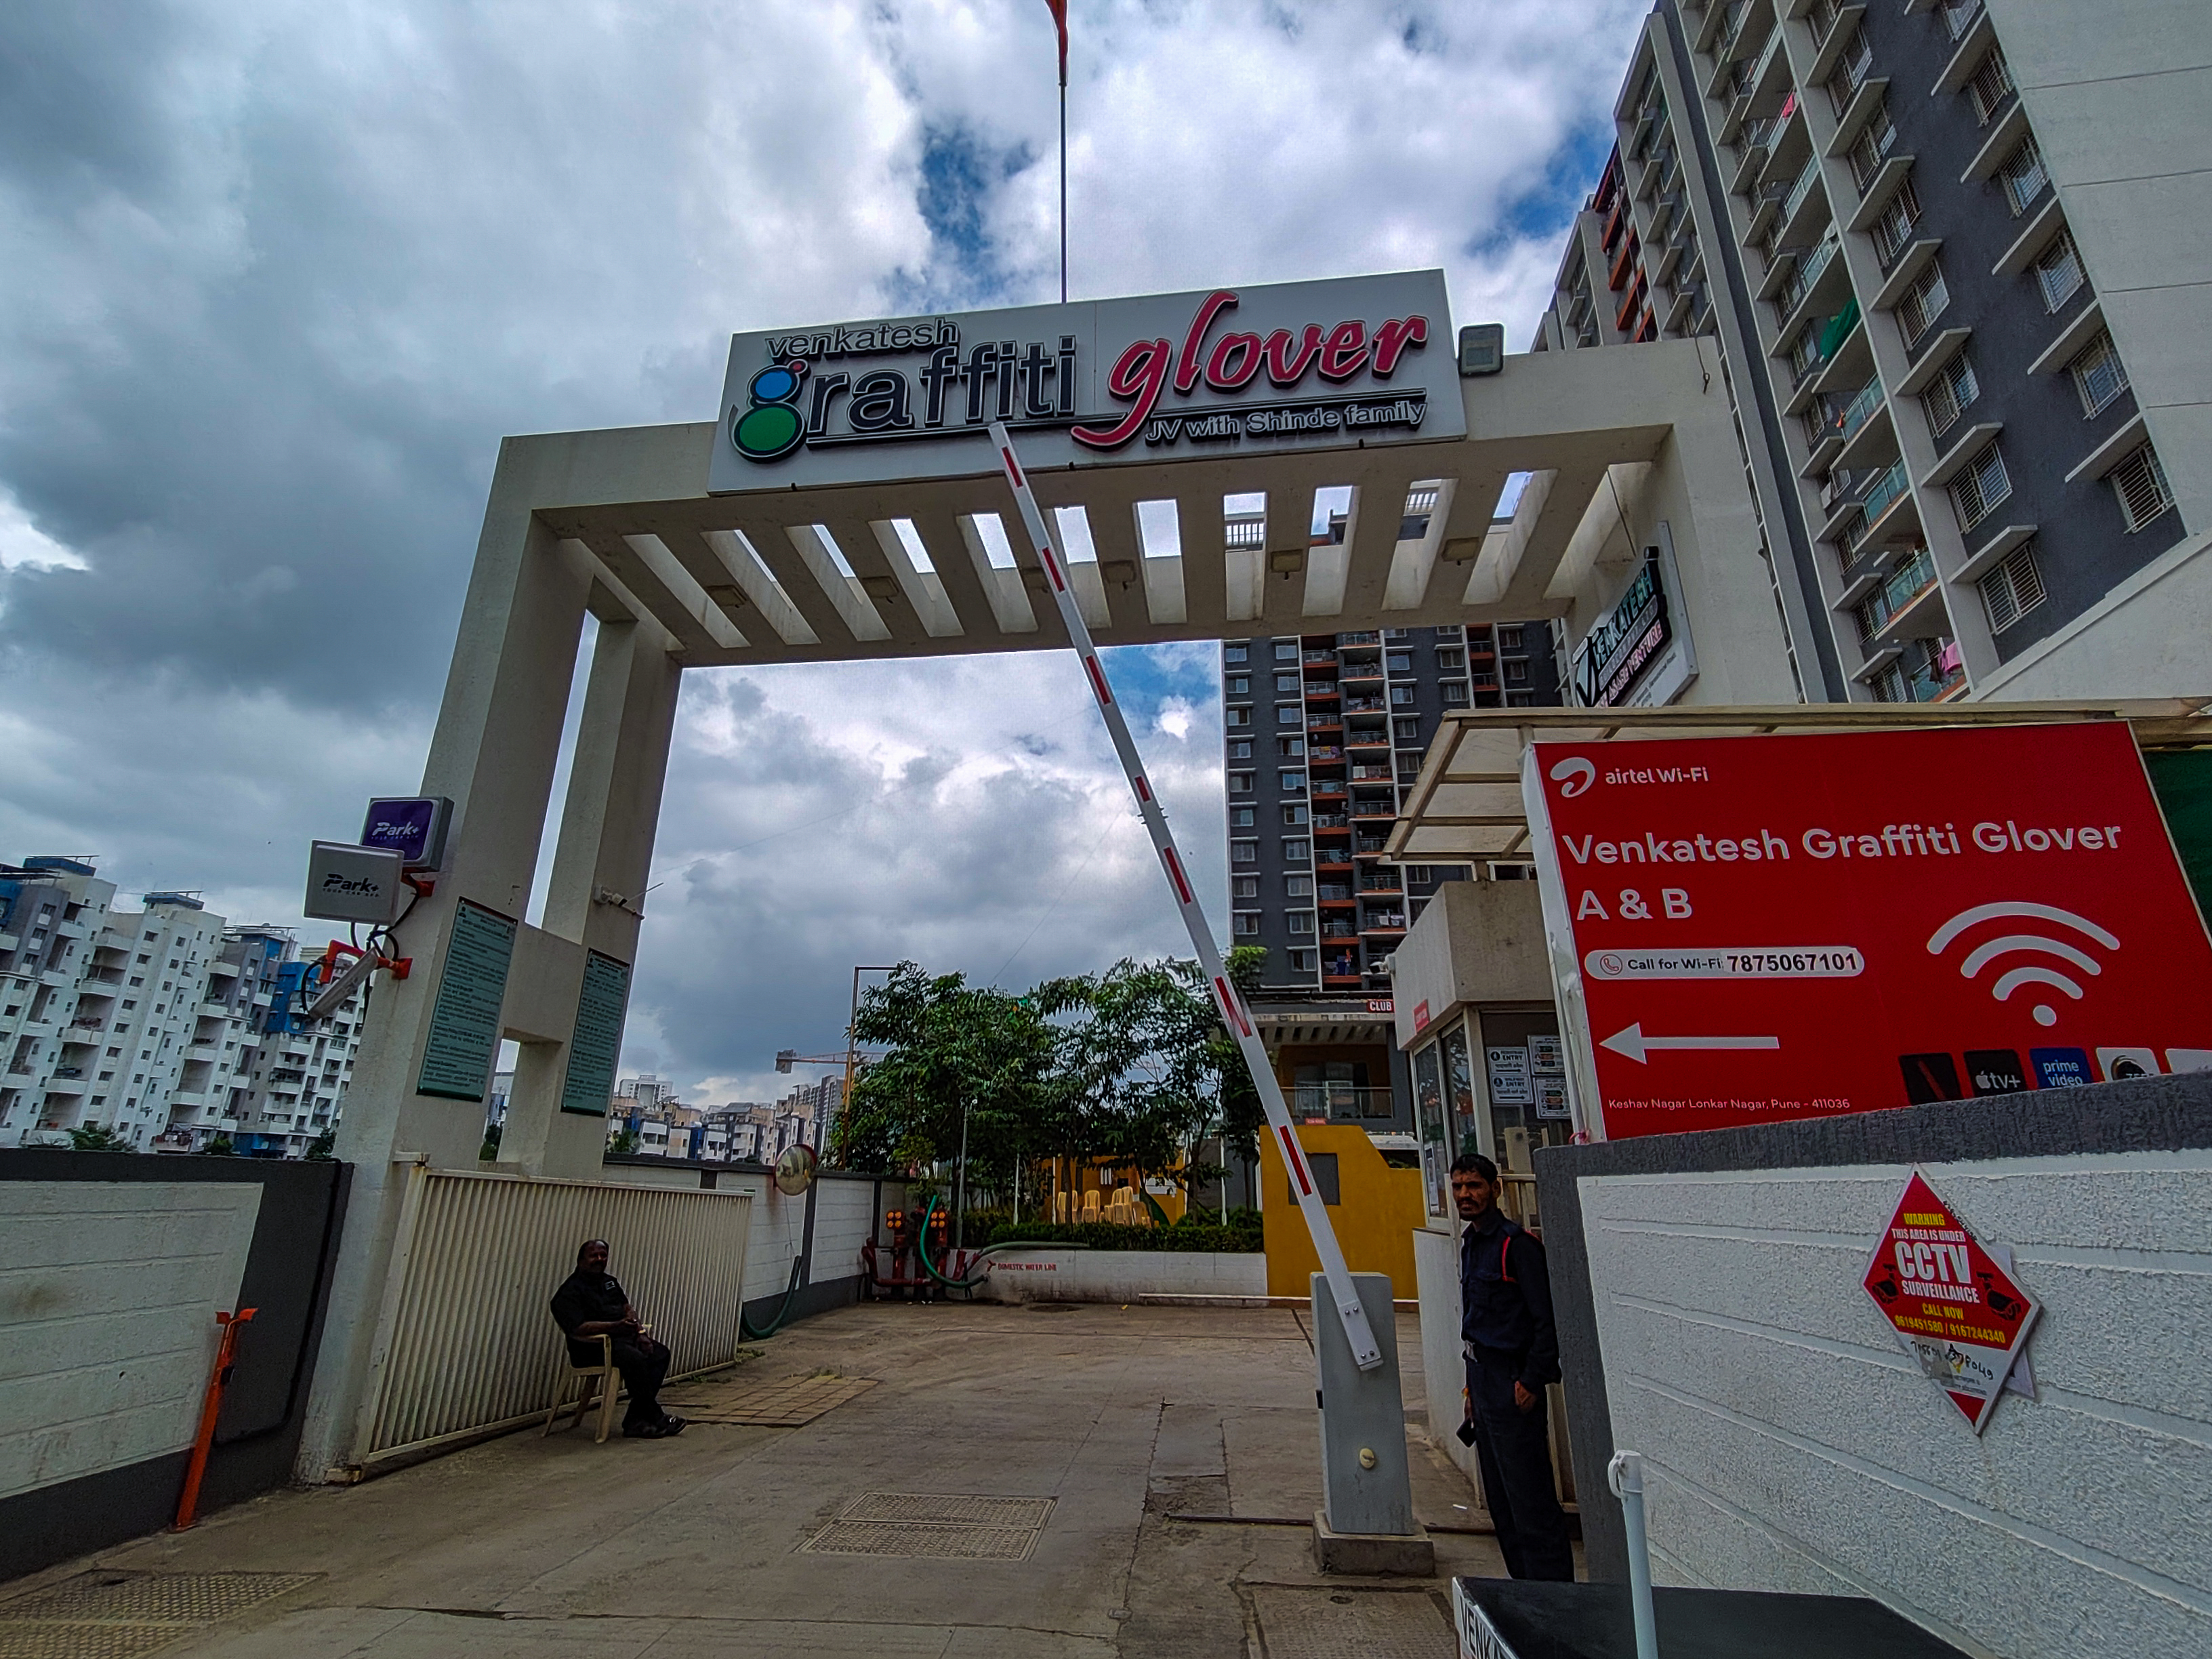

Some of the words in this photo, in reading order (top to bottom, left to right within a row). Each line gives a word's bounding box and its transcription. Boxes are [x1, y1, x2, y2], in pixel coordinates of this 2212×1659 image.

[765, 317, 960, 361] venkatesh
[728, 335, 1076, 464] graffiti
[1071, 289, 1429, 452] glover
[1145, 418, 1182, 444] JV
[1186, 413, 1240, 439] with
[1246, 405, 1341, 434] Shinde
[1345, 400, 1427, 428] family
[1627, 619, 1663, 675] VENTURE
[1605, 768, 1656, 784] airtel
[1656, 766, 1708, 783] Wi-Fi
[1562, 829, 1790, 864] Venkatesh
[1802, 823, 1961, 859] Graffiti
[1972, 820, 2121, 853] Glover
[1577, 890, 1609, 920] A
[1619, 888, 1654, 919] &
[1662, 888, 1692, 918] B
[1627, 958, 1654, 970] Call
[1658, 959, 1679, 970] for
[1726, 953, 1858, 972] 7875067101
[1370, 1001, 1392, 1011] CLUB
[2043, 1059, 2080, 1075] prime
[2047, 1073, 2083, 1086] video
[1608, 1099, 1648, 1109] Keshav
[1651, 1099, 1686, 1111] Nagar
[1689, 1099, 1727, 1109] Lonkar
[1730, 1099, 1769, 1111] Nagar,
[1771, 1099, 1801, 1109] Pune
[1811, 1099, 1850, 1109] 411036
[1904, 1213, 1946, 1226] WARNING
[1891, 1228, 1909, 1239] THIS
[1910, 1229, 1929, 1240] AREA
[1929, 1229, 1938, 1240] IS
[1938, 1230, 1966, 1242] UNDER
[998, 1263, 1024, 1271] DOMESTIC
[1044, 1263, 1057, 1271] LINE
[1895, 1242, 1971, 1284] CCTV
[1902, 1279, 1980, 1303] SURVEILLANCE
[1922, 1303, 1943, 1317] CALL
[1944, 1306, 1964, 1320] NOW
[1895, 1315, 1944, 1334] 9619451580
[1949, 1323, 2005, 1343] 9167244340
